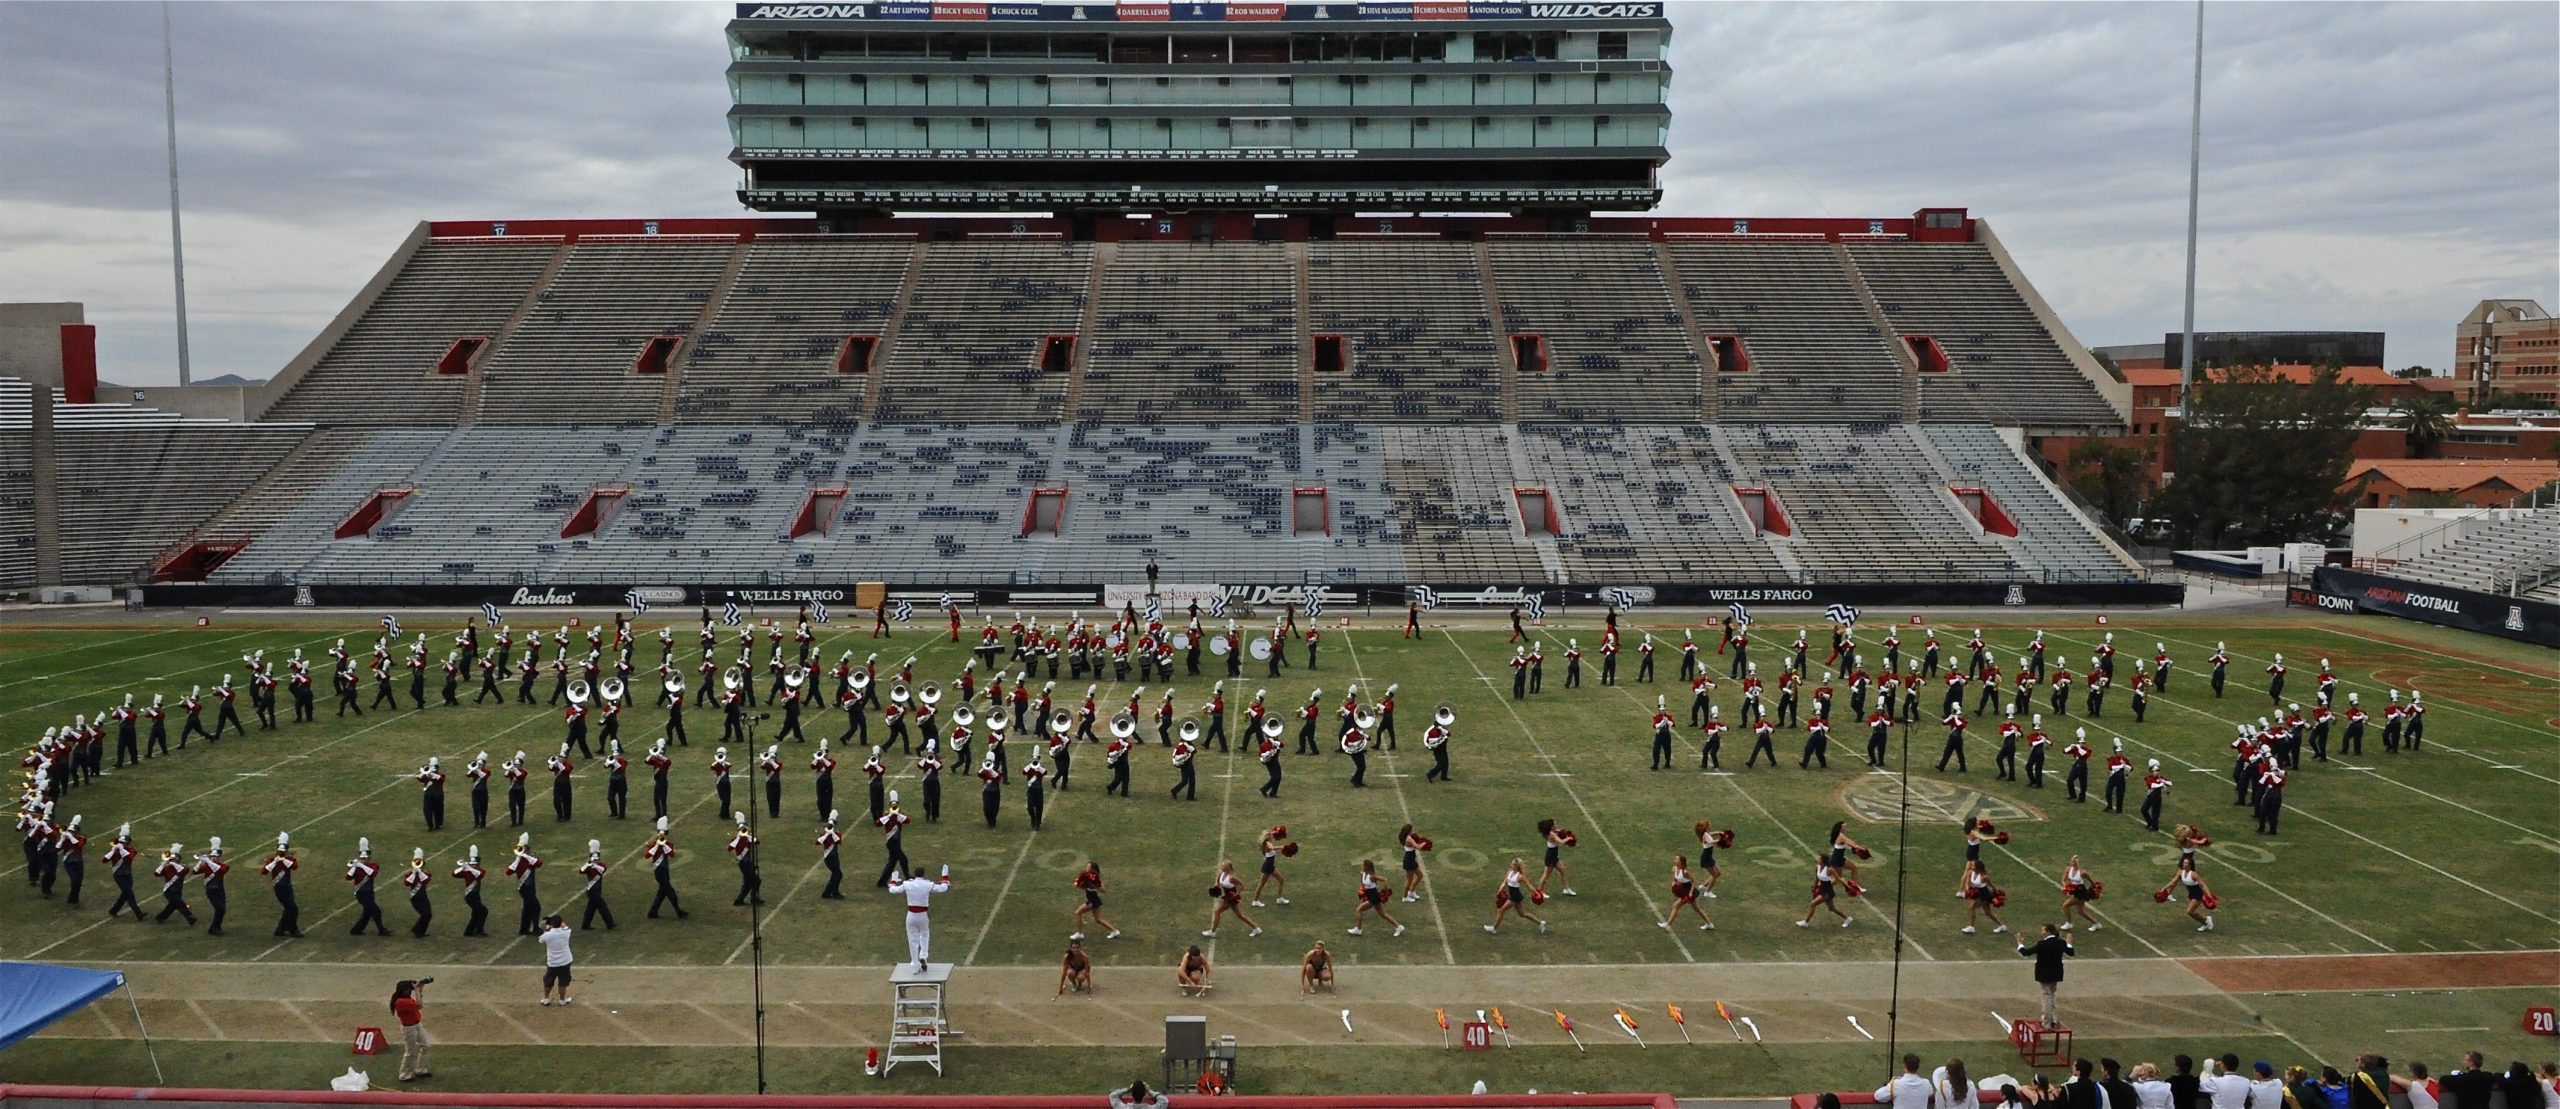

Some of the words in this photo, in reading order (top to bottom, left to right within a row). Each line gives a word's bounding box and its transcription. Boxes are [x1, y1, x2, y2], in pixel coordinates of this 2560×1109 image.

[750, 5, 865, 18] ARIZONA
[880, 6, 888, 14] 22
[1531, 4, 1656, 18] WILDCATS
[494, 227, 504, 236] 17
[645, 226, 657, 236] 18
[1012, 224, 1025, 233] 20
[1159, 223, 1171, 232] 21
[1380, 224, 1393, 233] 22
[1734, 224, 1747, 234] 24
[1870, 225, 1883, 234] 25
[134, 391, 145, 400] 16
[511, 586, 577, 605] Bashas'
[739, 590, 791, 601] WELLS
[794, 590, 844, 601] FARGO
[1107, 592, 1142, 601] UNIVERSITY
[1184, 592, 1201, 601] BAND
[1709, 589, 1761, 601] WELLS
[1764, 589, 1813, 601] FARGO
[2318, 595, 2354, 612] DOWN
[2405, 592, 2460, 613] FOOTBALL
[2533, 1012, 2553, 1032] 20
[1467, 1026, 1486, 1046] 40
[355, 1032, 375, 1051] 40
